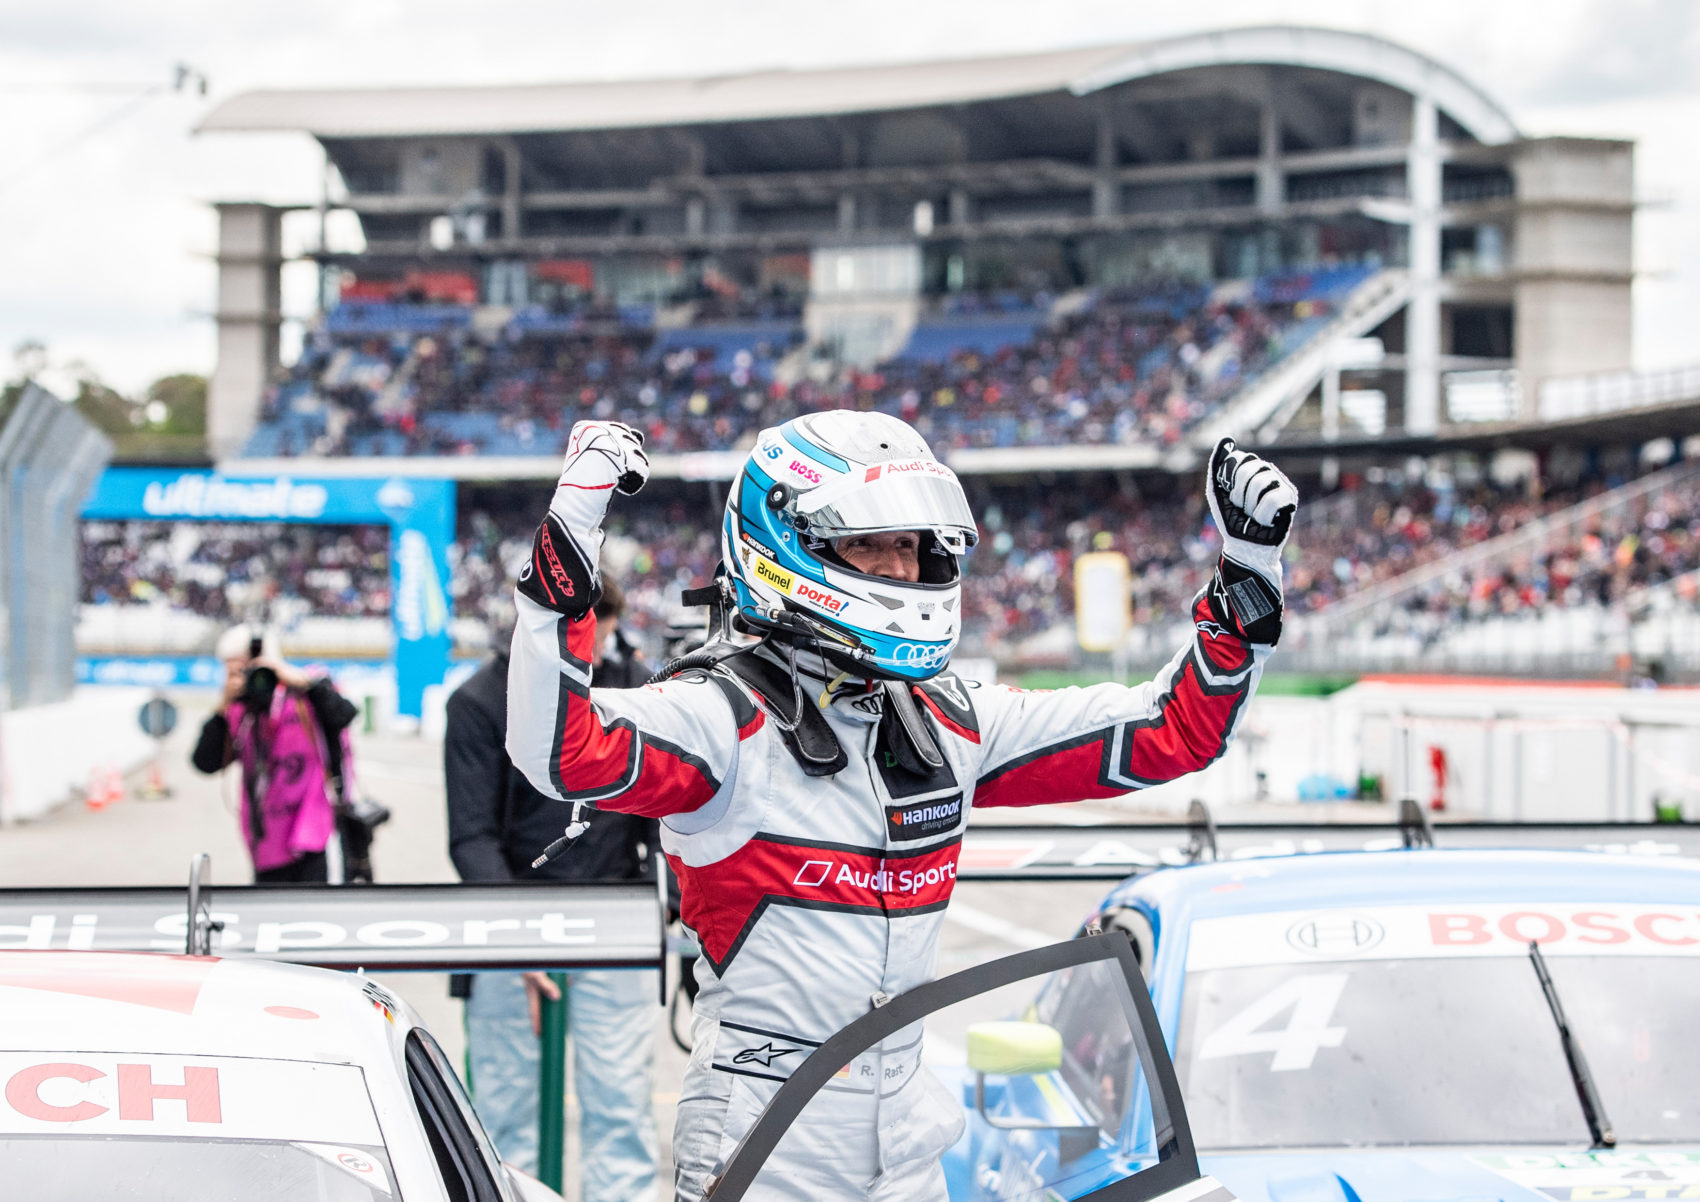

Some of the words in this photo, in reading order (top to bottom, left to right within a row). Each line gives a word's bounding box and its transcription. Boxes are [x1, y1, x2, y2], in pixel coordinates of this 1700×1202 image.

[789, 460, 823, 484] BOSS
[887, 461, 925, 474] Audi
[757, 561, 791, 590] Brunel
[796, 584, 850, 617] porta!
[835, 858, 894, 893] Audi
[899, 859, 956, 895] Sport
[149, 911, 597, 953] Sport
[1427, 910, 1700, 947] BOSC
[1198, 972, 1350, 1073] 4
[860, 1064, 875, 1077] R.
[4, 1061, 223, 1125] CH
